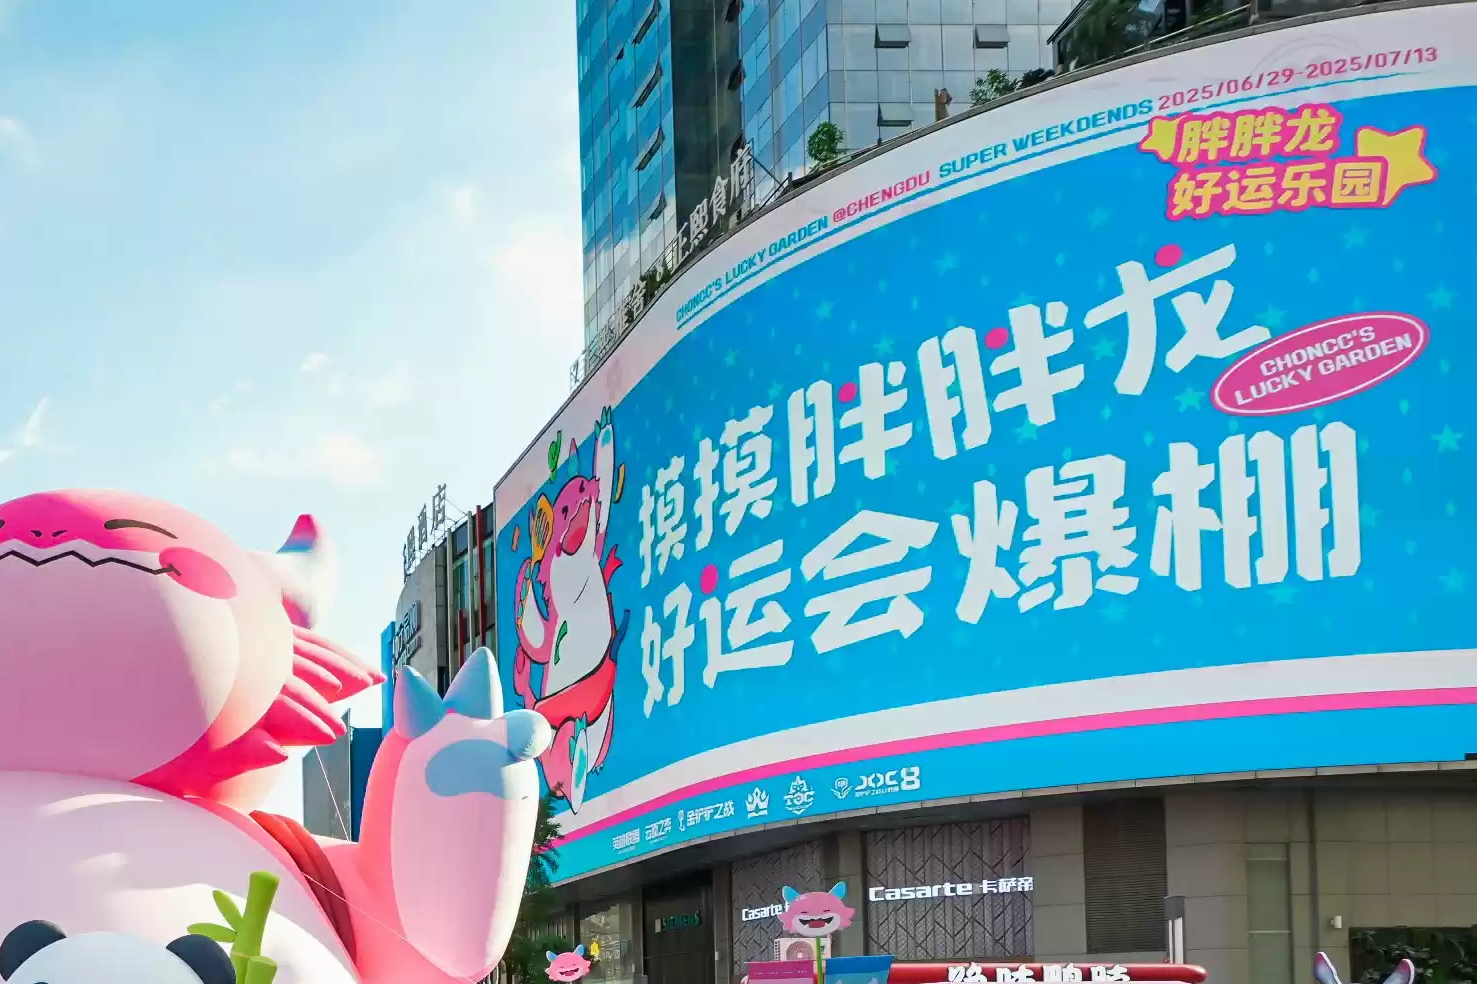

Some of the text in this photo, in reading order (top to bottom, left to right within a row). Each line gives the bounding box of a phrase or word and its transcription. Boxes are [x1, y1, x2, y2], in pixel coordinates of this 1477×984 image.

[1178, 108, 1336, 162] 胖胖龙
[676, 47, 1438, 322] CHONCC'S LUCKY GARDEN @CHENGDU SUPER WEEKDENDS 2025/06/29-2025/07/13
[1172, 161, 1383, 217] 好运乐园
[1234, 333, 1412, 405] LUCKY GARDEN
[1260, 326, 1375, 377] CHONCC'S
[638, 243, 1271, 588] 摸摸胖胖龙
[640, 421, 1361, 718] 好运会爆棚
[686, 800, 735, 828] 金铲铲之战
[742, 903, 782, 921] Casarte
[869, 876, 1034, 902] Casarte 卡萨帝
[663, 911, 699, 929] SIEMENS
